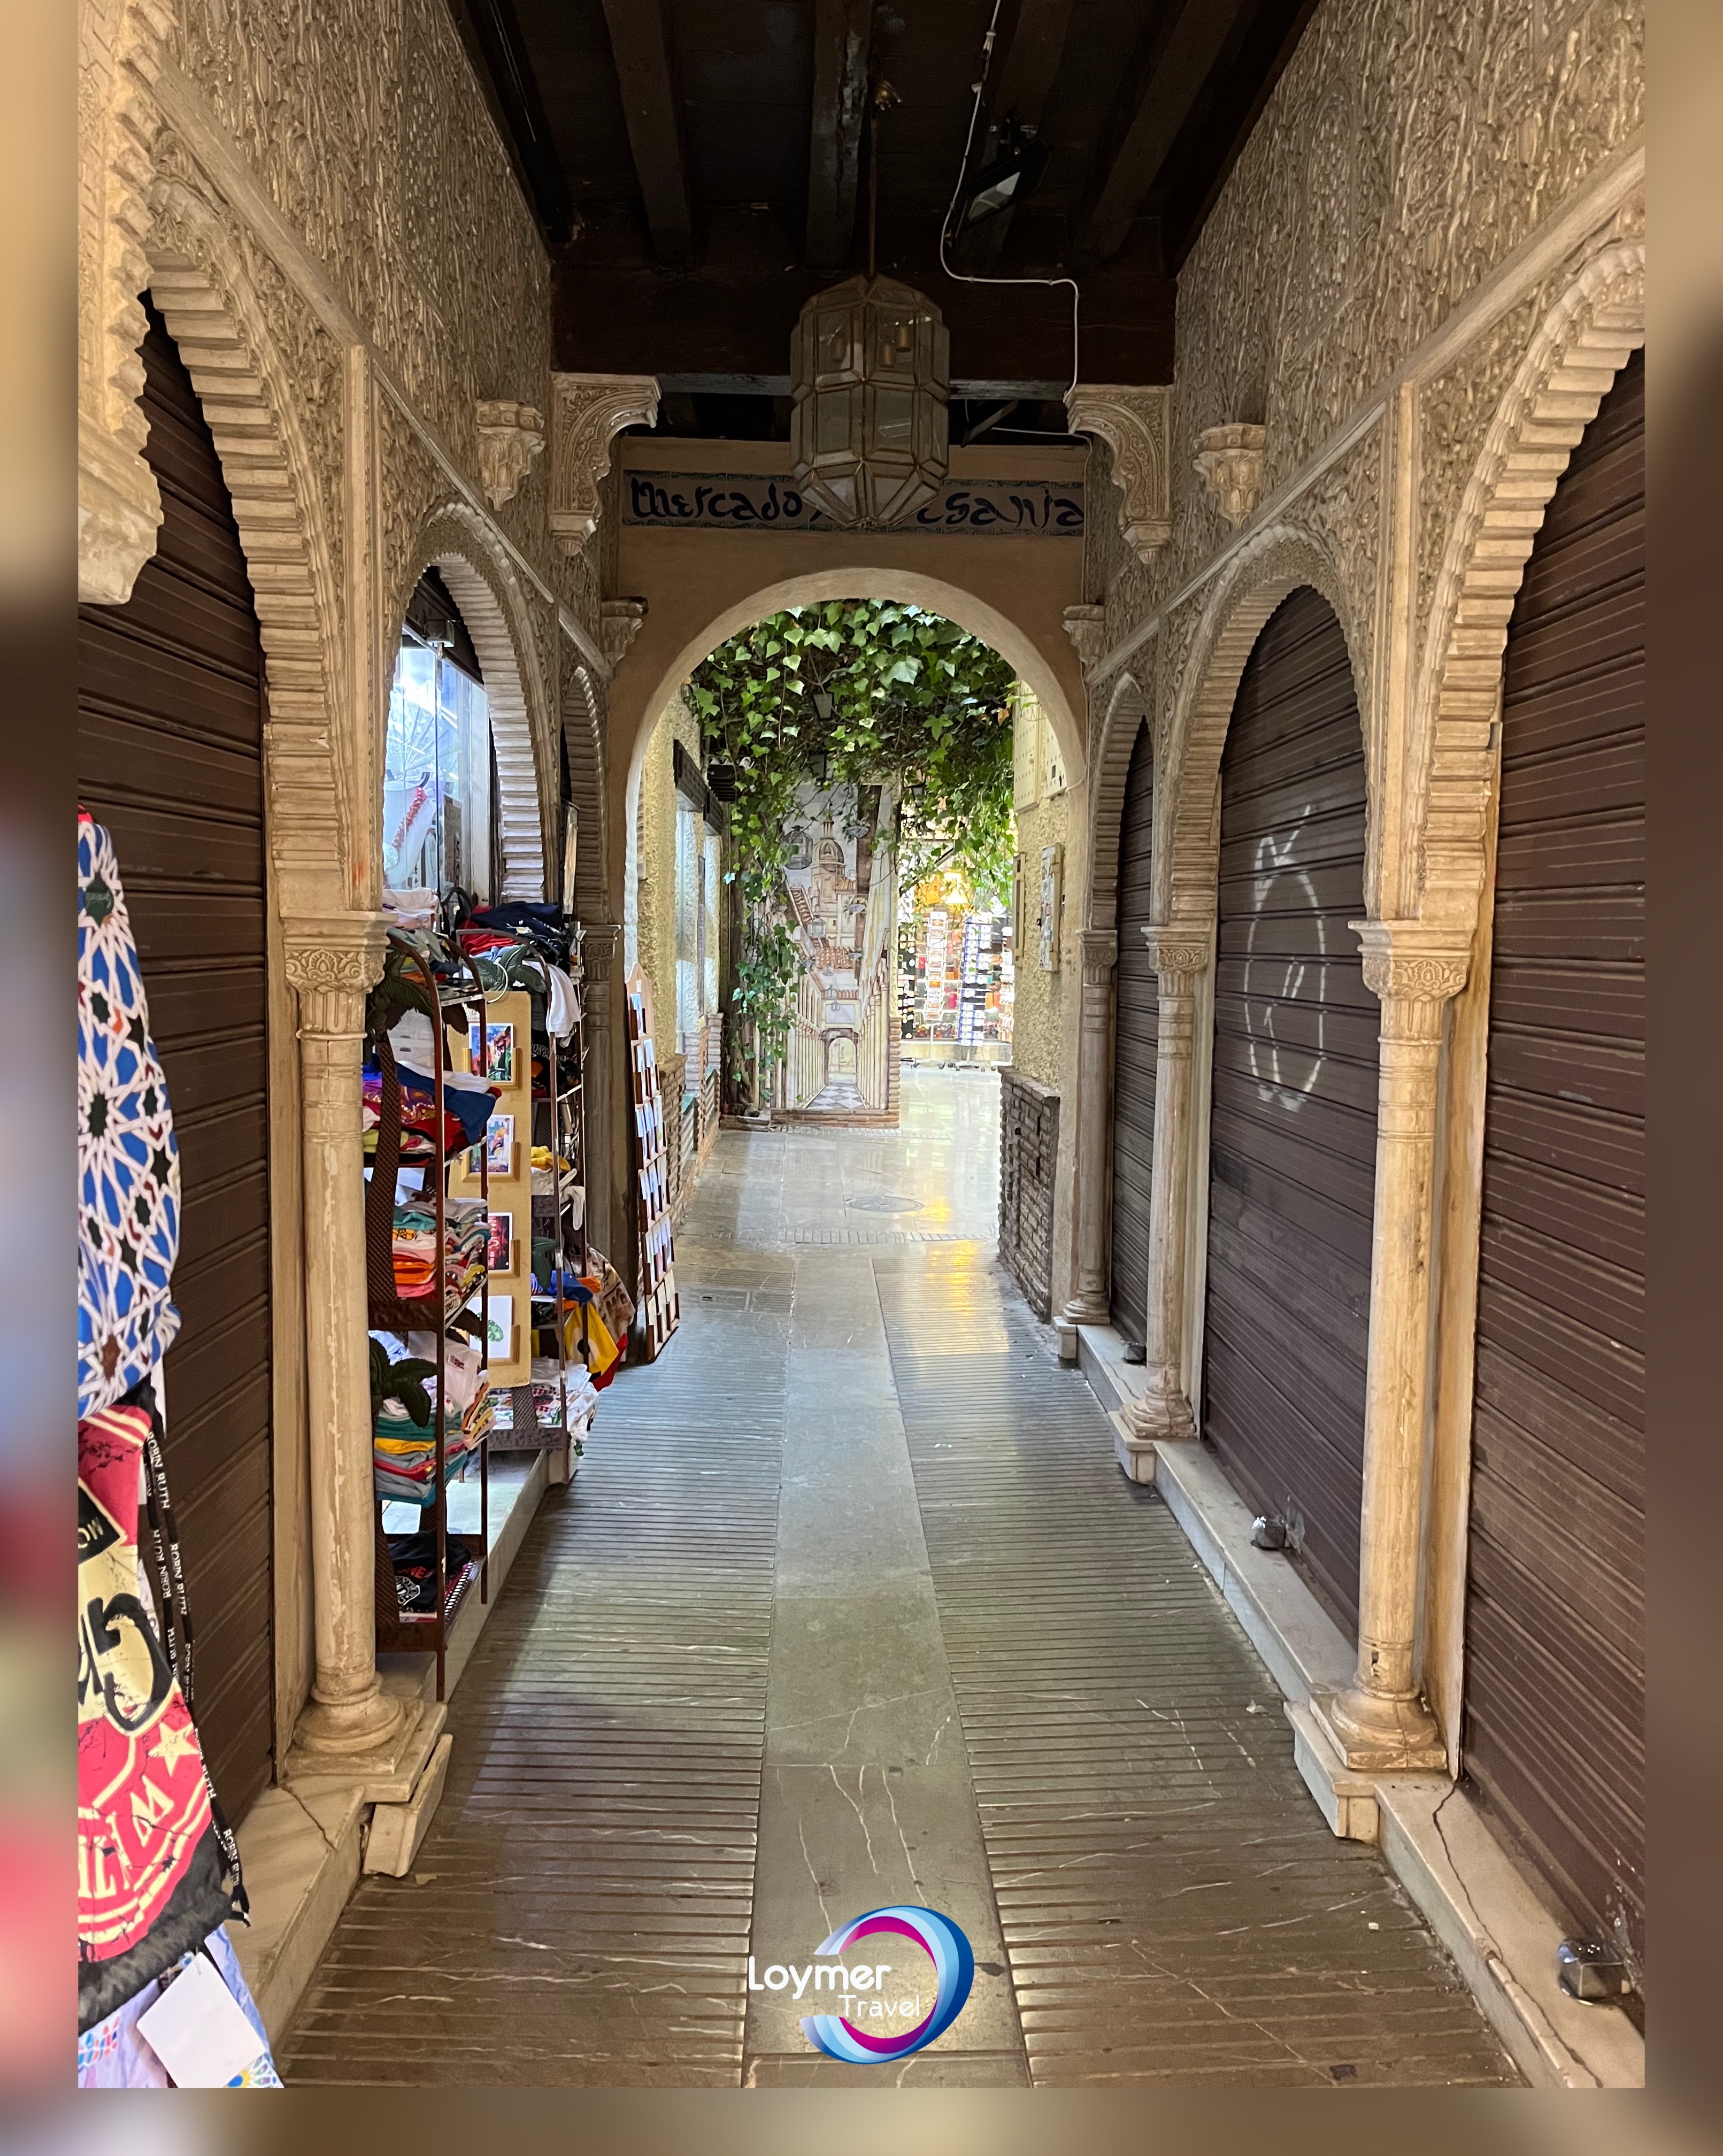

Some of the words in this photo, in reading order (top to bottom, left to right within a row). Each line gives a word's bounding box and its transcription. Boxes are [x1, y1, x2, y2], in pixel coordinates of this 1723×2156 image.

[631, 478, 802, 522] Mercado
[147, 1431, 163, 1467] ROBIN
[157, 1472, 170, 1508] RUTH
[170, 1542, 183, 1579] ROBIN
[158, 1565, 171, 1598] ROBIN
[223, 1829, 238, 1862] ROBIN
